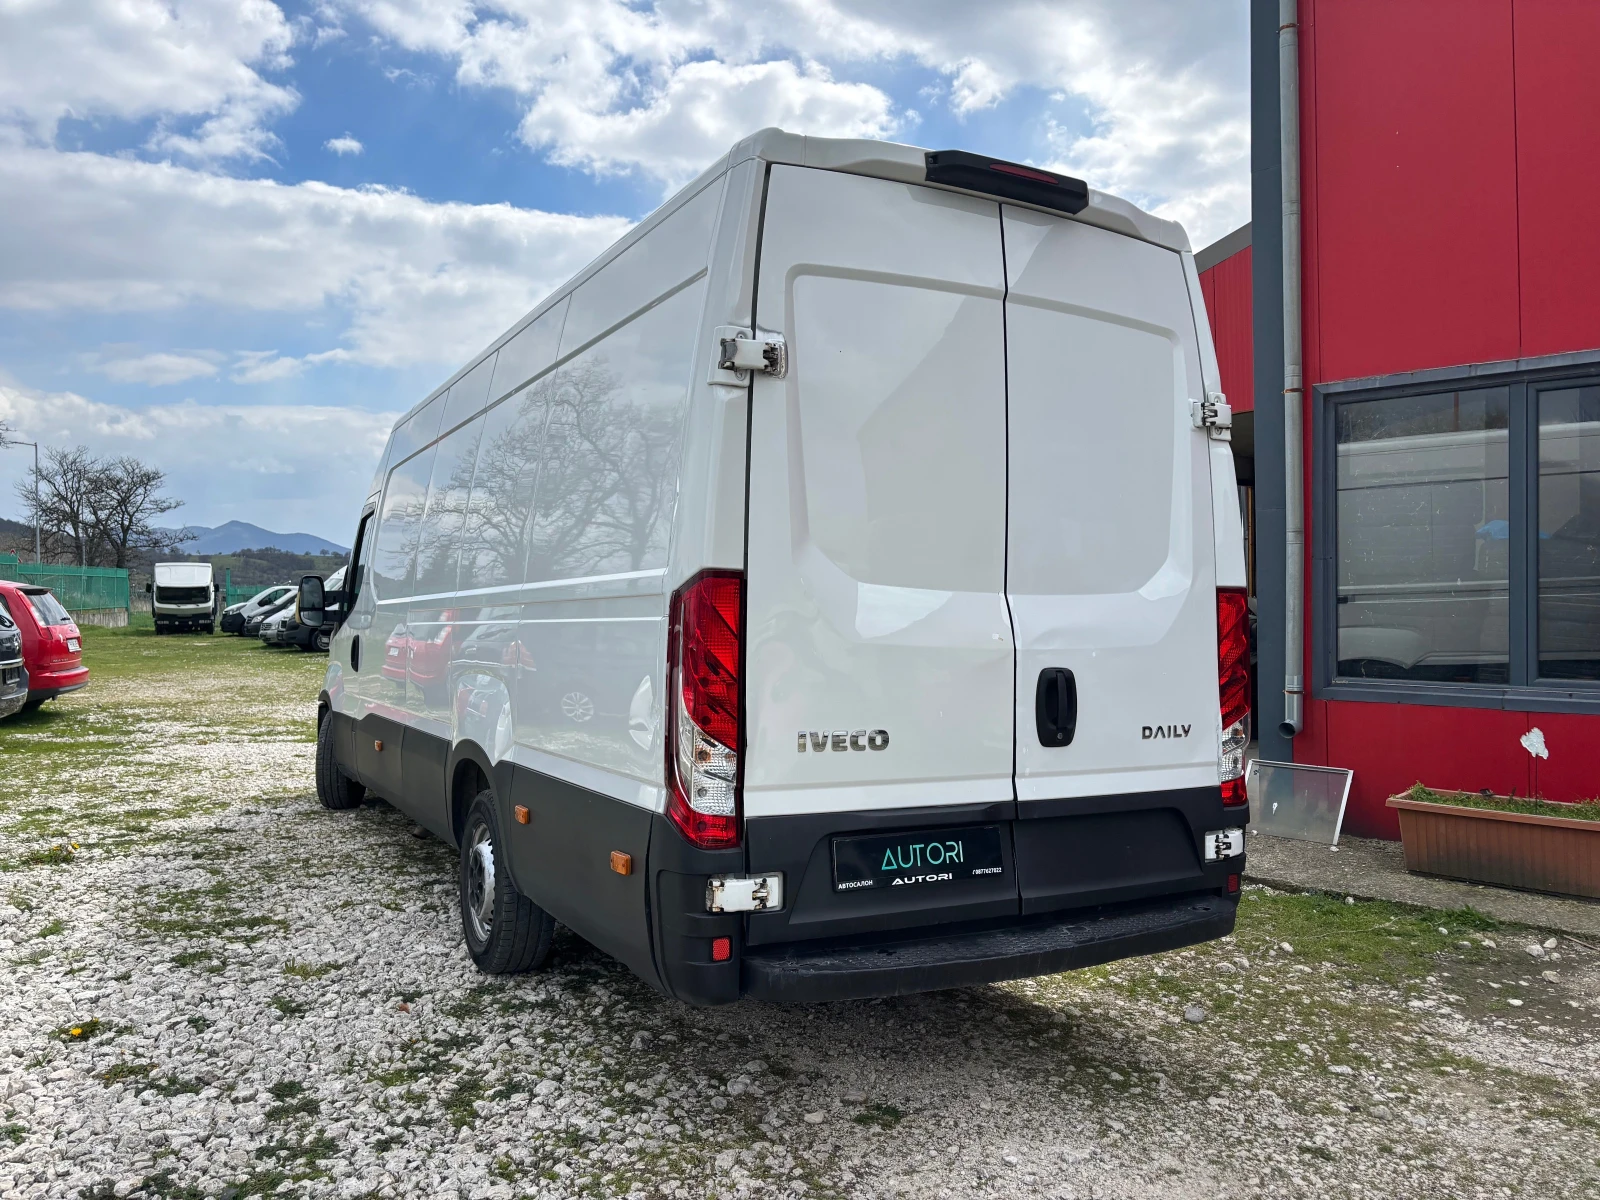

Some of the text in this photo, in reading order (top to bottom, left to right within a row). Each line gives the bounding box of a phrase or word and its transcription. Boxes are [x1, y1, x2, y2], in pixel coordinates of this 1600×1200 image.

[1141, 724, 1192, 740] DAILY
[797, 729, 890, 753] IVECO
[881, 840, 964, 871] AUTORI
[837, 879, 873, 890] АВТОСАЛОН
[891, 872, 953, 886] AUTORI
